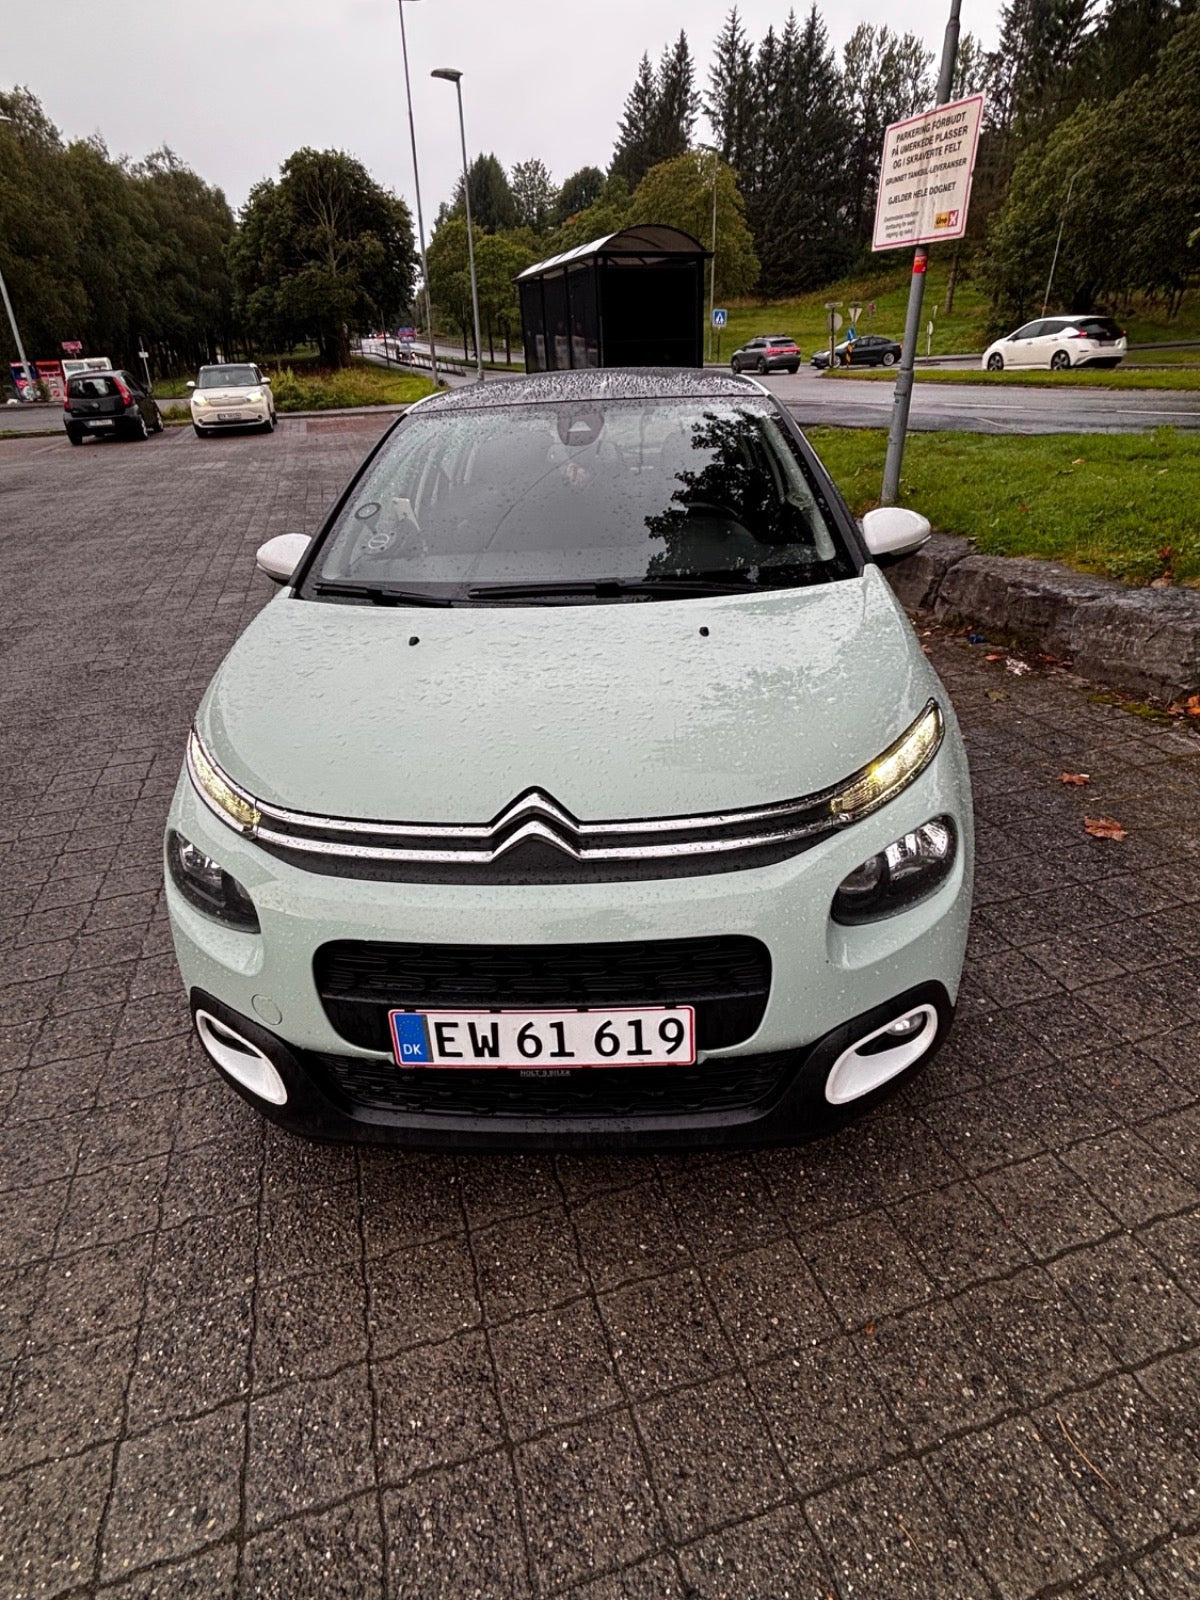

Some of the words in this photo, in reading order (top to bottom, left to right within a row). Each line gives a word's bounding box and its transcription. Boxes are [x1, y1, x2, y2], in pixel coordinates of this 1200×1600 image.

[891, 145, 899, 157] PÅ
[899, 136, 934, 155] UMERKEDE
[935, 125, 969, 144] PLASSER
[896, 122, 931, 143] PARKERING
[931, 111, 967, 132] FORBUDT
[892, 158, 902, 170] OG
[906, 146, 943, 165] SKRAVERTE
[943, 141, 962, 155] FELT
[912, 187, 929, 199] HELE
[403, 1043, 422, 1055] DK
[434, 1021, 500, 1058] EW
[516, 1020, 575, 1058] 61
[594, 1017, 685, 1057] 619
